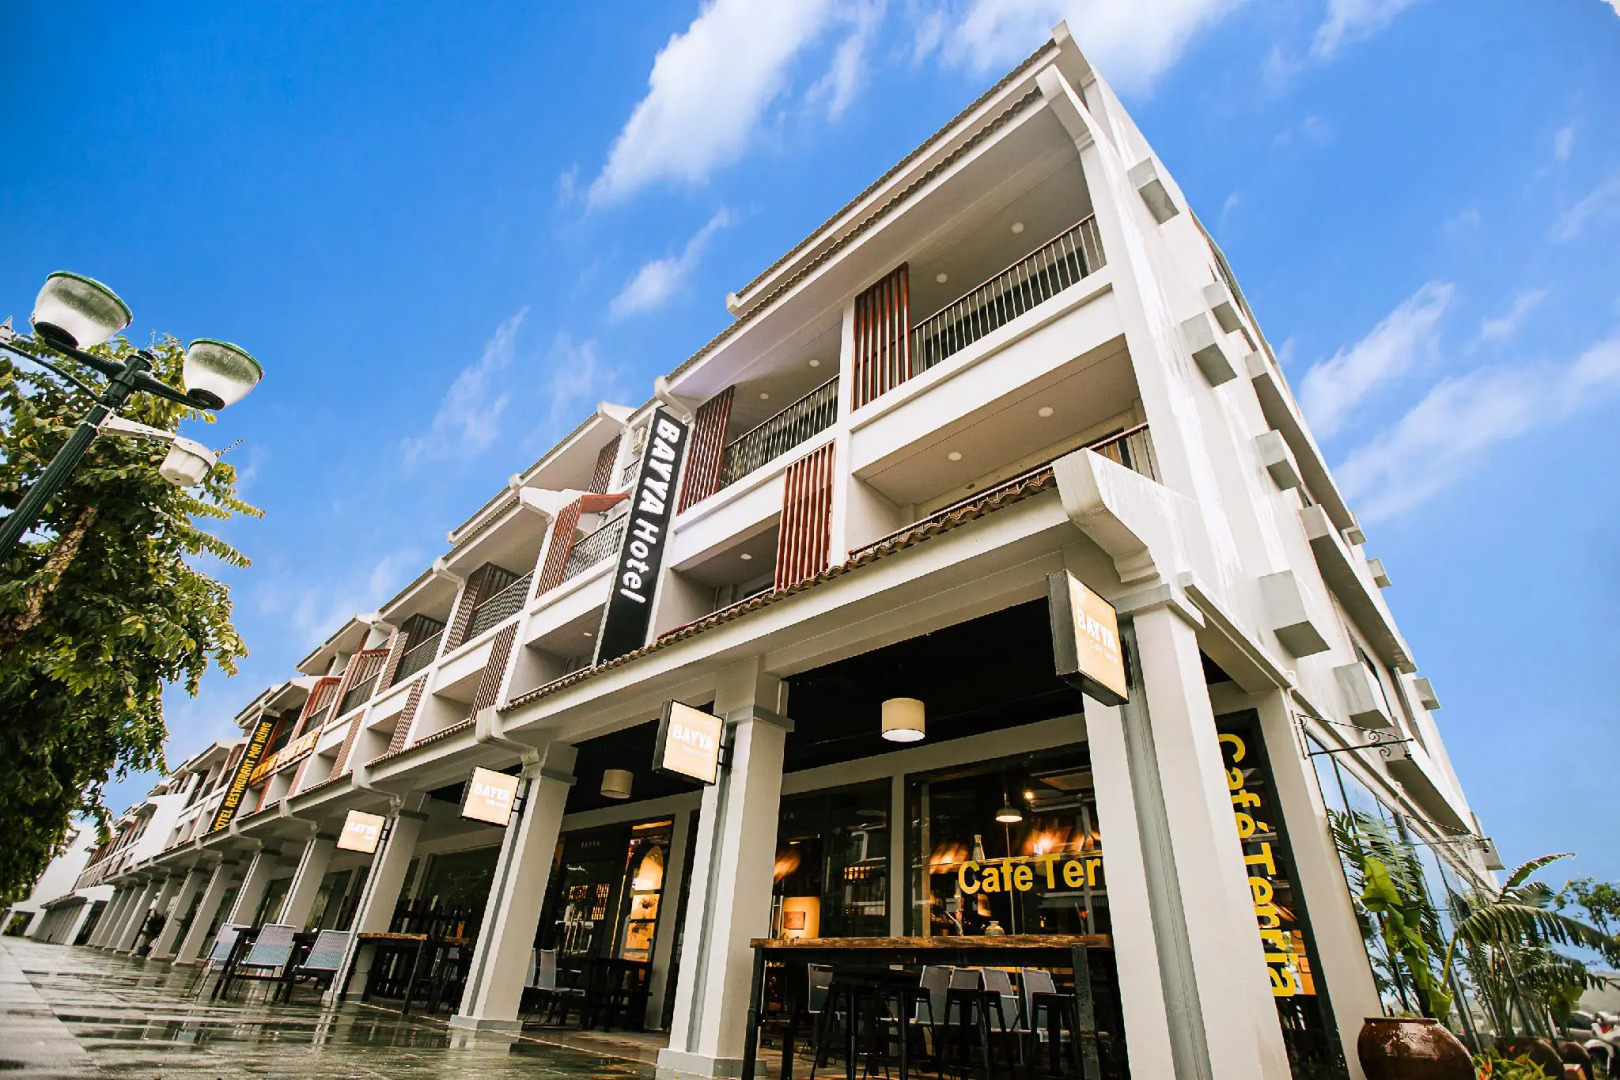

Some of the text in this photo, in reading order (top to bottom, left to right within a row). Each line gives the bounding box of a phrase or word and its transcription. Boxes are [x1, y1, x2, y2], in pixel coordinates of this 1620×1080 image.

[620, 418, 680, 603] BAYYA Hotel
[224, 758, 256, 808] RESTAURANT
[247, 744, 263, 758] MAI
[958, 853, 1105, 895] Café Ter
